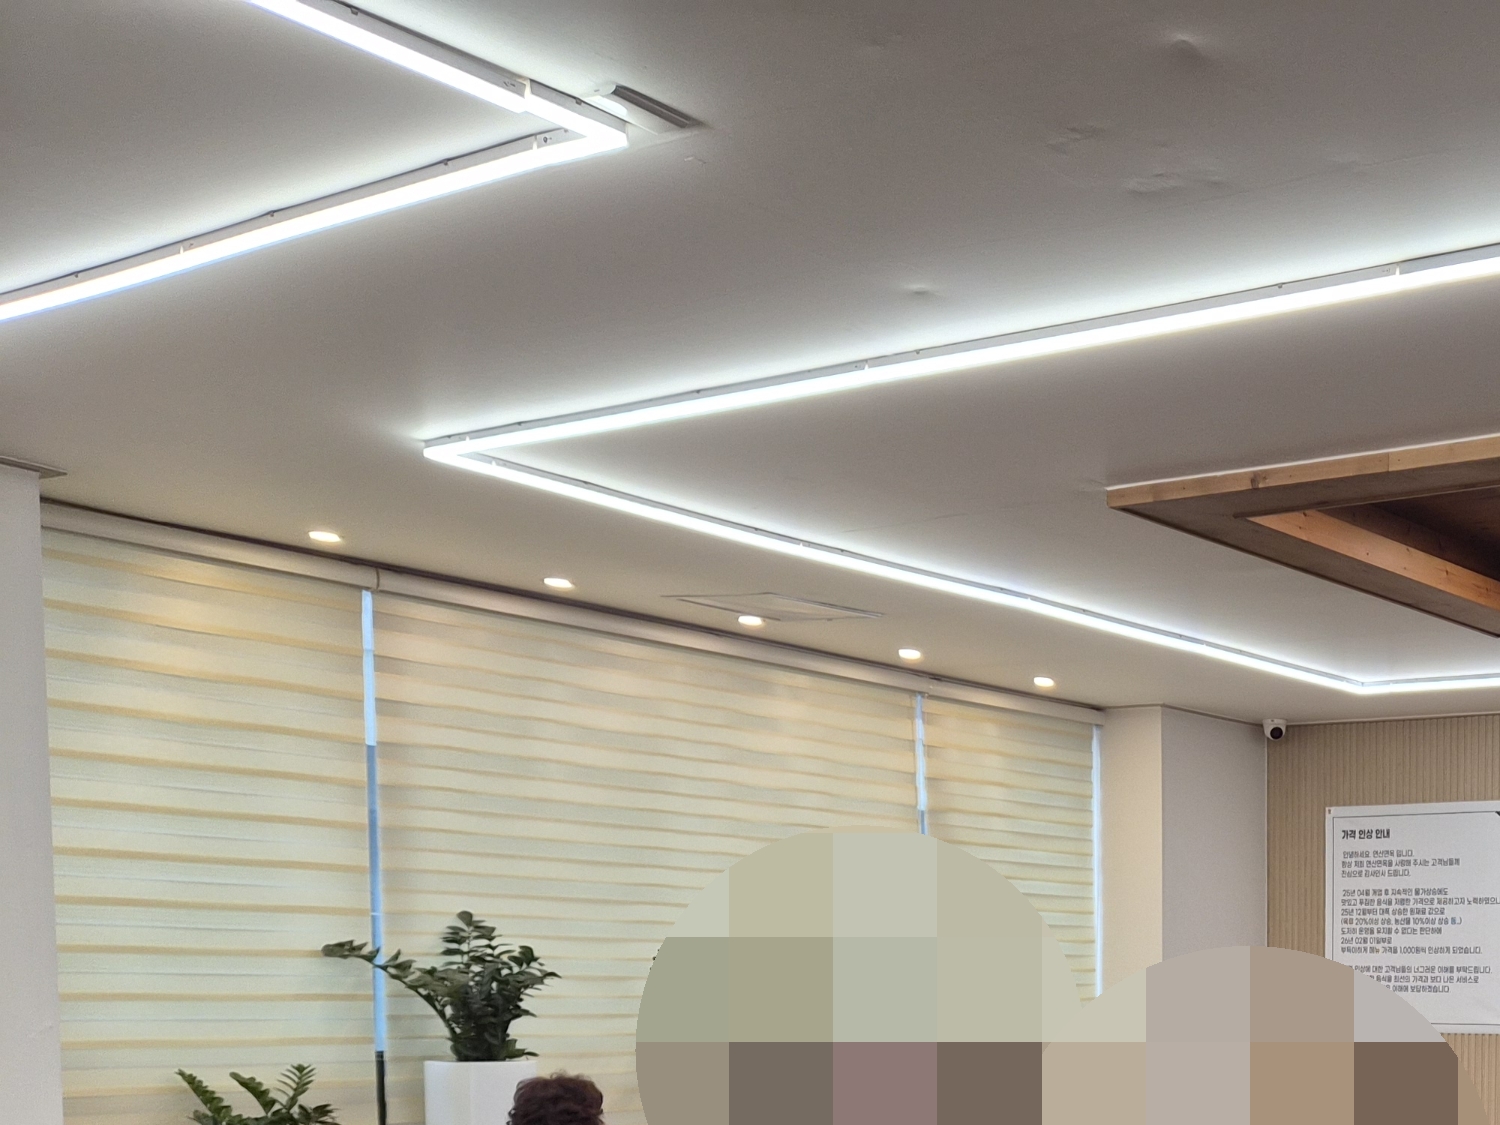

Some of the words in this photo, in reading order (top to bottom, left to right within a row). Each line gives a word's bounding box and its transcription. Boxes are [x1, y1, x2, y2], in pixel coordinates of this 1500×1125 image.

[1342, 830, 1356, 840] 가격
[1358, 829, 1374, 839] 인상
[1375, 828, 1391, 839] 안내
[1396, 849, 1414, 857] 입니다.
[1412, 859, 1430, 867] 주시는
[1341, 870, 1363, 878] 진심으로
[1364, 870, 1386, 878] 감사인사
[1387, 869, 1411, 877] 드립니다.
[1390, 888, 1413, 896] 지속적인
[1412, 898, 1435, 906] 가격으로
[1341, 908, 1354, 916] 25년
[1355, 918, 1379, 926] 20%이상
[1412, 917, 1437, 925] 10%이상
[1437, 917, 1449, 925] 상승
[1394, 927, 1400, 935] 수
[1381, 946, 1398, 954] 가격을
[1427, 946, 1451, 954] 인상하게
